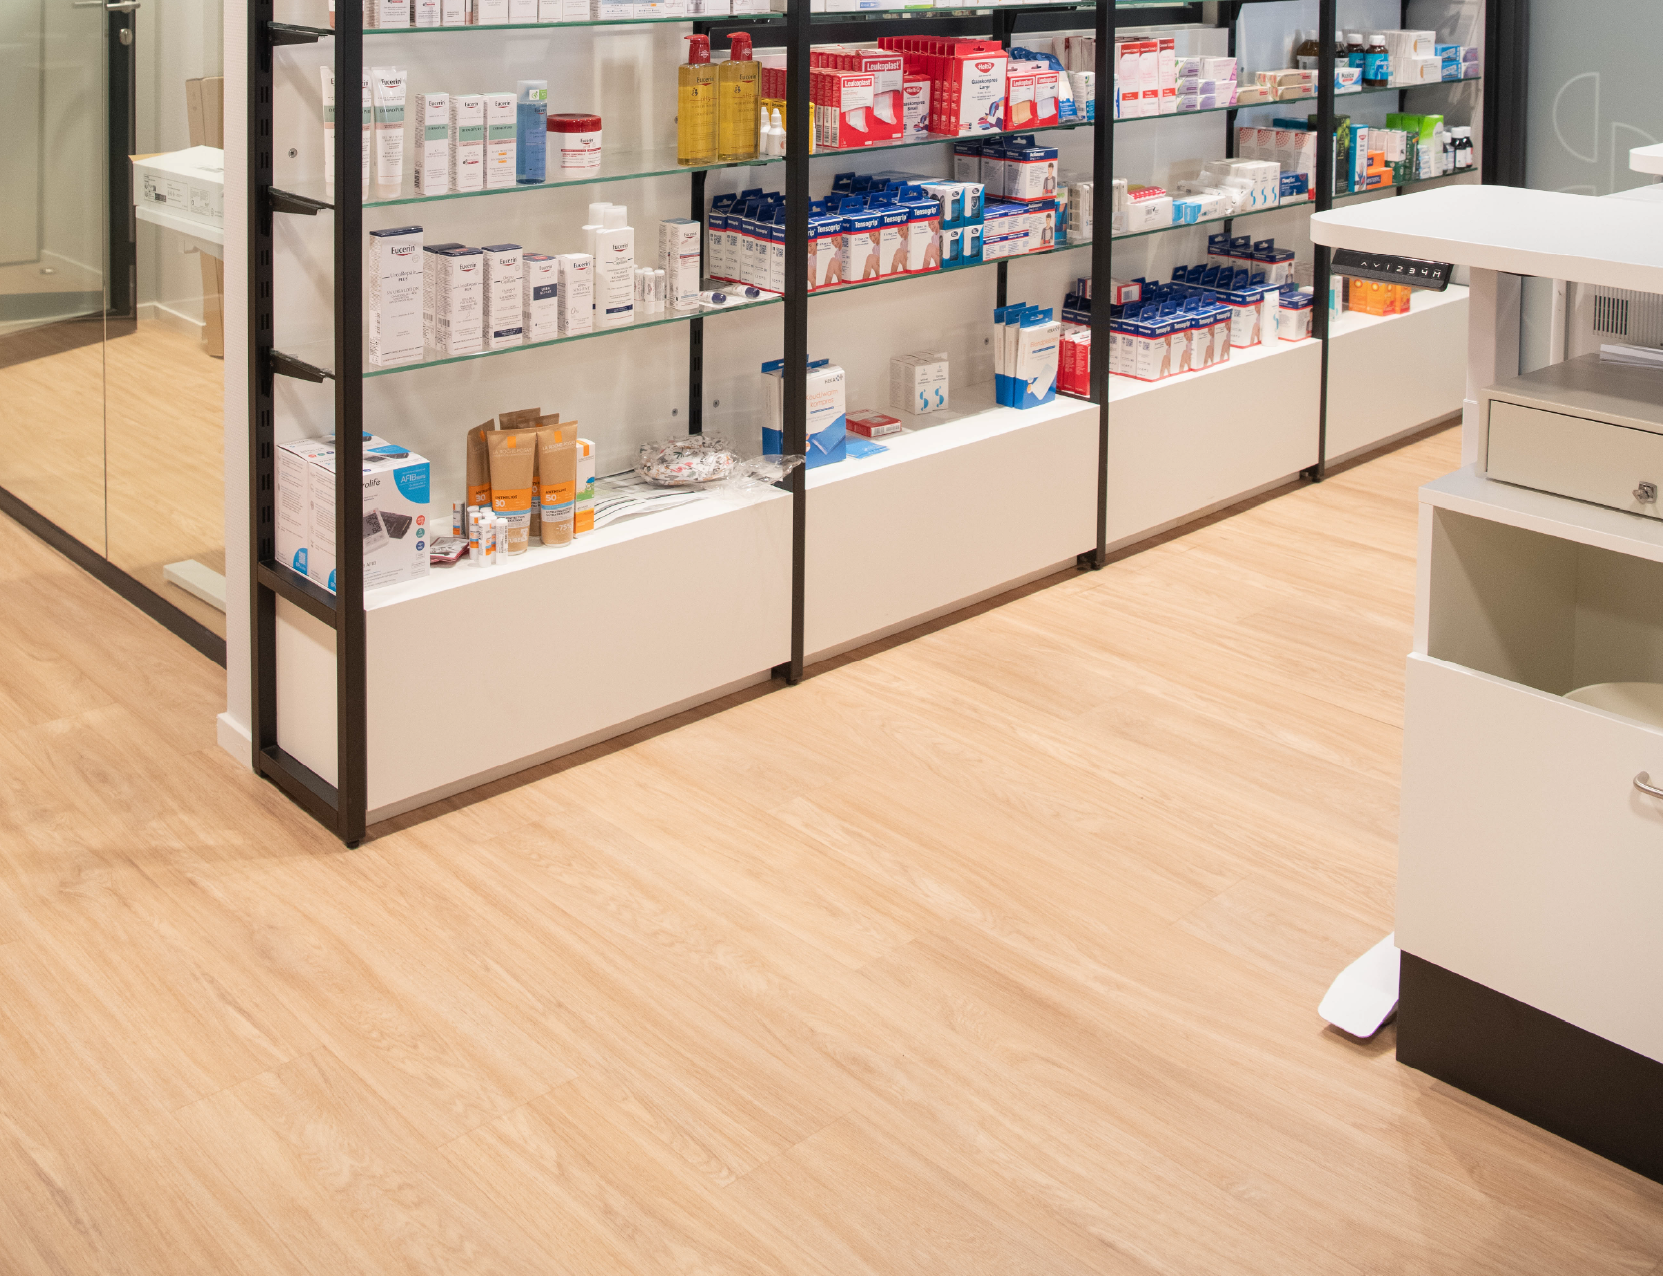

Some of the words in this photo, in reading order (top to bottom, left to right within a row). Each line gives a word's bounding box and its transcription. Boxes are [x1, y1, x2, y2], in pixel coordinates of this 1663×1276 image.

[867, 61, 900, 72] Leukoplast
[696, 76, 714, 84] Eucerin
[739, 73, 757, 81] Eucerin
[844, 79, 871, 88] Leukoplast
[1013, 79, 1033, 87] Leukoplast
[914, 206, 938, 216] Tensogrip
[883, 213, 908, 223] Tensogrip
[817, 223, 842, 233] Tensogrip
[854, 219, 879, 229] Tensogrip
[391, 244, 415, 254] Eucerin
[612, 242, 629, 250] Eucerin
[499, 257, 517, 265] Eucerin
[573, 261, 591, 269] Eucerin
[459, 262, 477, 270] Eucerin
[1245, 293, 1261, 302] Tensogrip
[1198, 315, 1214, 325] Tensogrip
[1216, 311, 1231, 320] Tensogrip
[1173, 320, 1190, 330] Tensogrip
[1155, 325, 1171, 335] Tensogrip
[810, 397, 834, 408] kompres
[475, 494, 486, 502] 30
[545, 494, 557, 502] 50
[495, 499, 506, 507] 30
[556, 523, 572, 531] -75%
